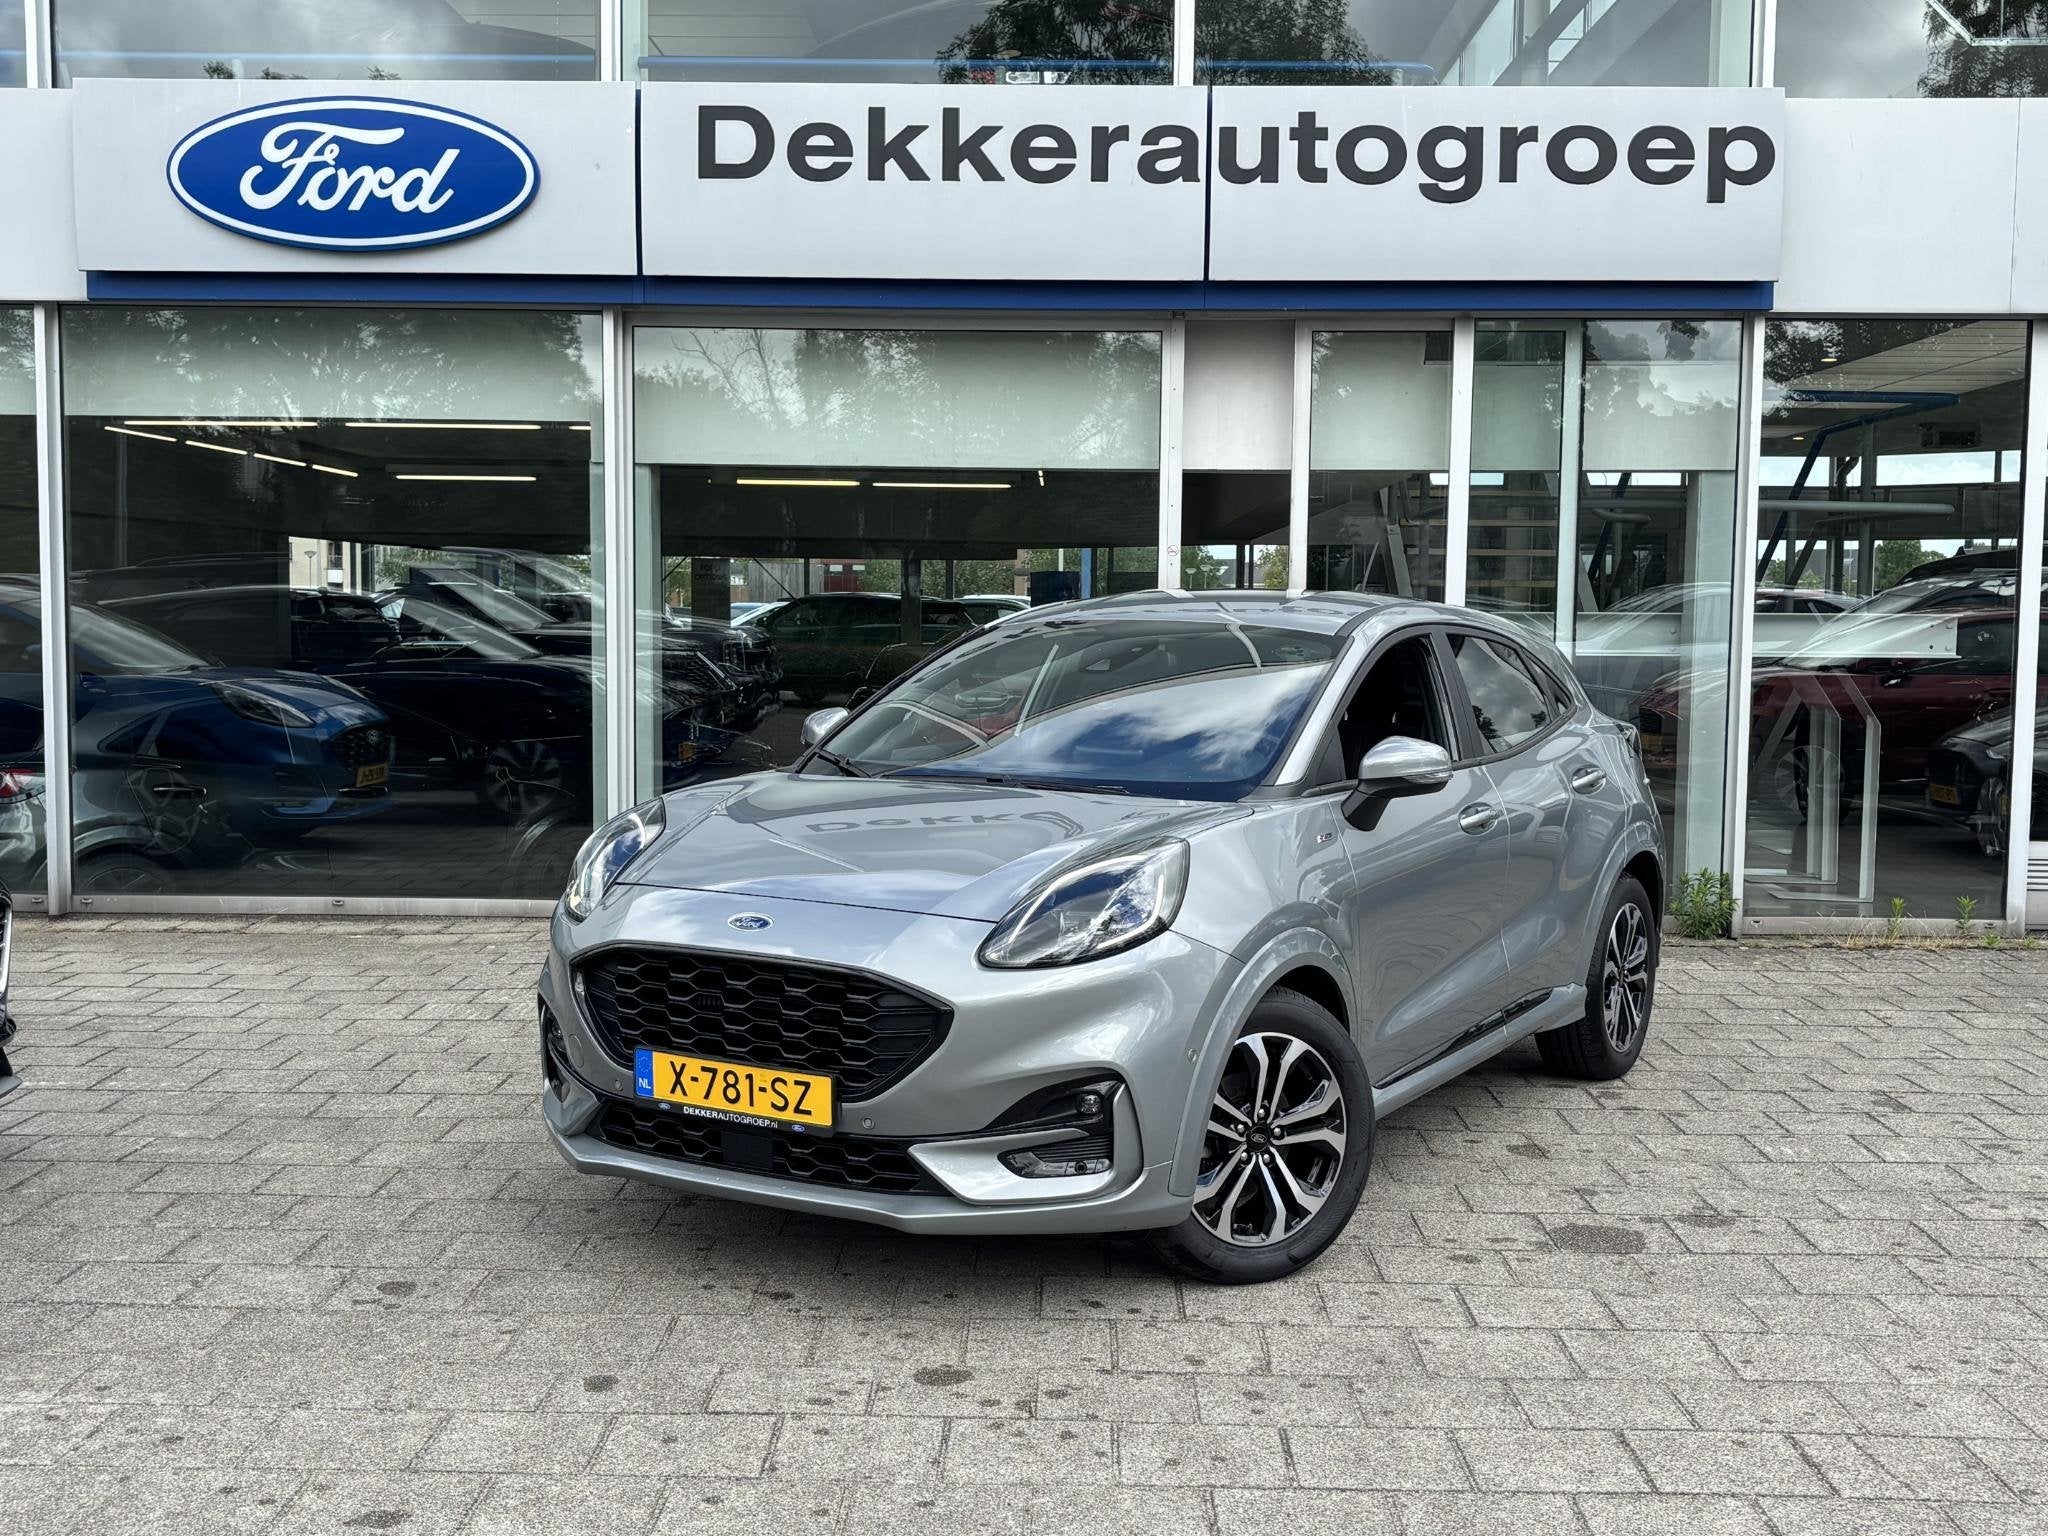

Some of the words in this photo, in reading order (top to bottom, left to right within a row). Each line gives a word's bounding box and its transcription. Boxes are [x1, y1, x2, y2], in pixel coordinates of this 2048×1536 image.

[239, 121, 461, 214] Ford
[698, 105, 1776, 204] Dekkerautogroep
[638, 1077, 651, 1089] NL
[668, 1061, 813, 1116] X-781-SZ
